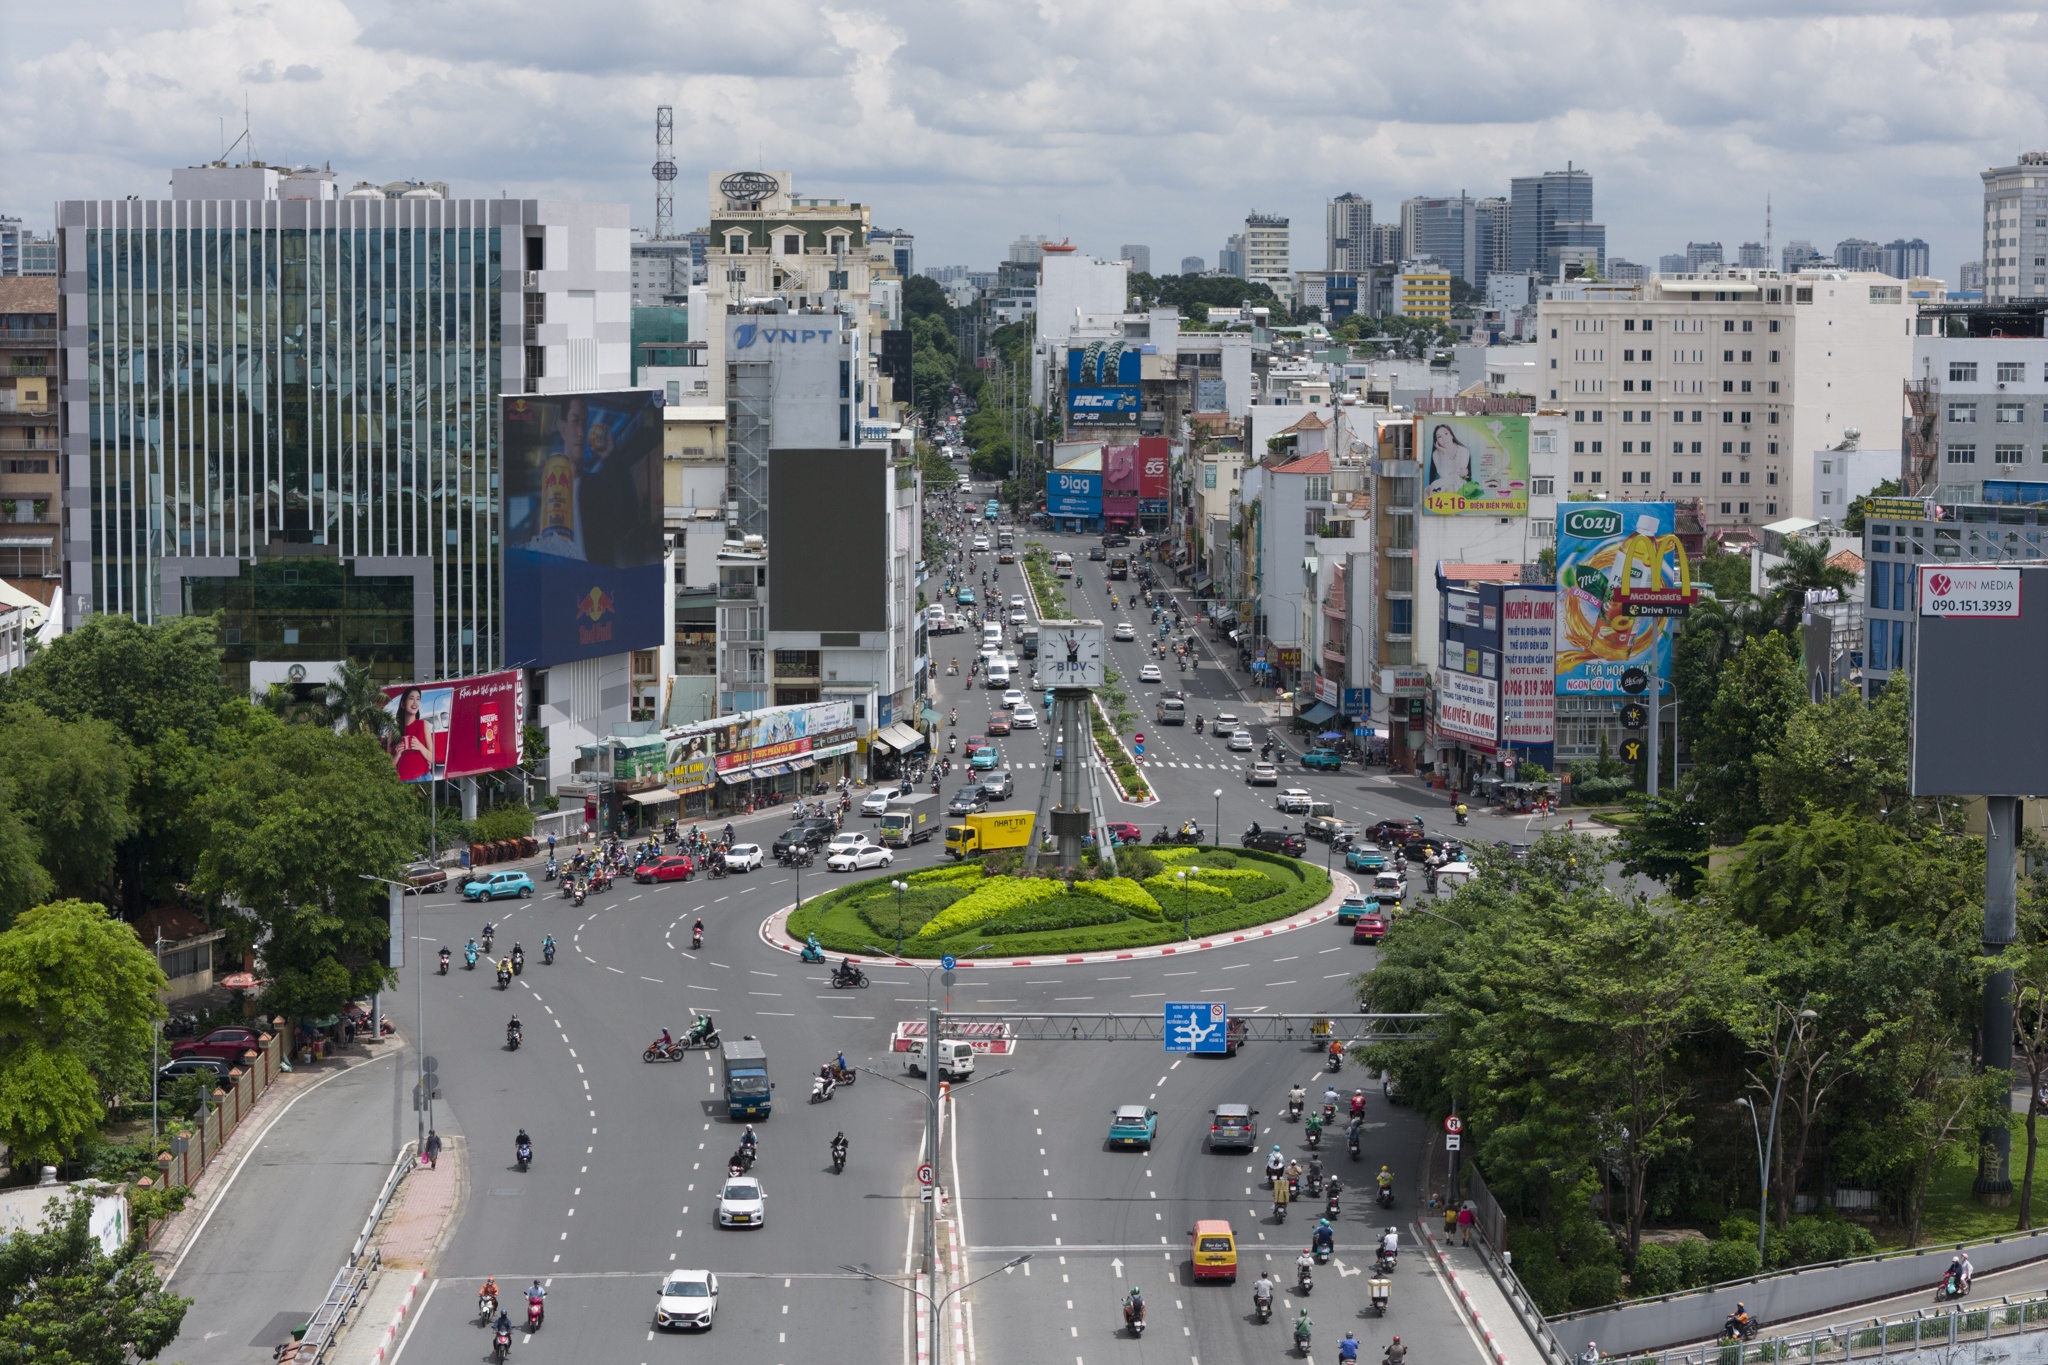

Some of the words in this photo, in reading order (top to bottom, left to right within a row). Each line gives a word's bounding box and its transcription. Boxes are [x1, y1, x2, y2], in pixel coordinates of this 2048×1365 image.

[722, 182, 776, 191] VINACONEX
[762, 329, 833, 344] VNPT
[1145, 461, 1165, 475] 5G
[1427, 496, 1466, 510] 14-16
[1469, 501, 1484, 511] ĐIỆN
[1485, 501, 1500, 509] BIÊN
[1570, 514, 1616, 533] Cozy
[1953, 580, 1977, 590] WIN
[1980, 580, 2014, 590] MEDIA
[1629, 592, 1682, 601] McDonald's
[1448, 602, 1466, 612] Panasonic
[1505, 595, 1533, 620] NGUYỄN
[1533, 601, 1555, 620] GIANG
[1641, 606, 1664, 615] Drive
[1665, 606, 1683, 615] Thru
[1932, 600, 2012, 611] 090.151.3939
[1540, 642, 1549, 650] LED
[1057, 661, 1087, 671] BIDV
[1510, 667, 1548, 675] HOTLINE:
[1585, 661, 1603, 676] TRÀ
[1606, 666, 1625, 676] HOA
[1411, 677, 1425, 687] ANH
[1567, 679, 1589, 690] NGON
[1524, 680, 1538, 696] 819
[1540, 680, 1554, 696] 300
[1442, 704, 1472, 725] NGUYỄN
[1473, 713, 1495, 731] GIANG
[841, 730, 857, 741] MATCHA
[743, 750, 756, 761] HÀG
